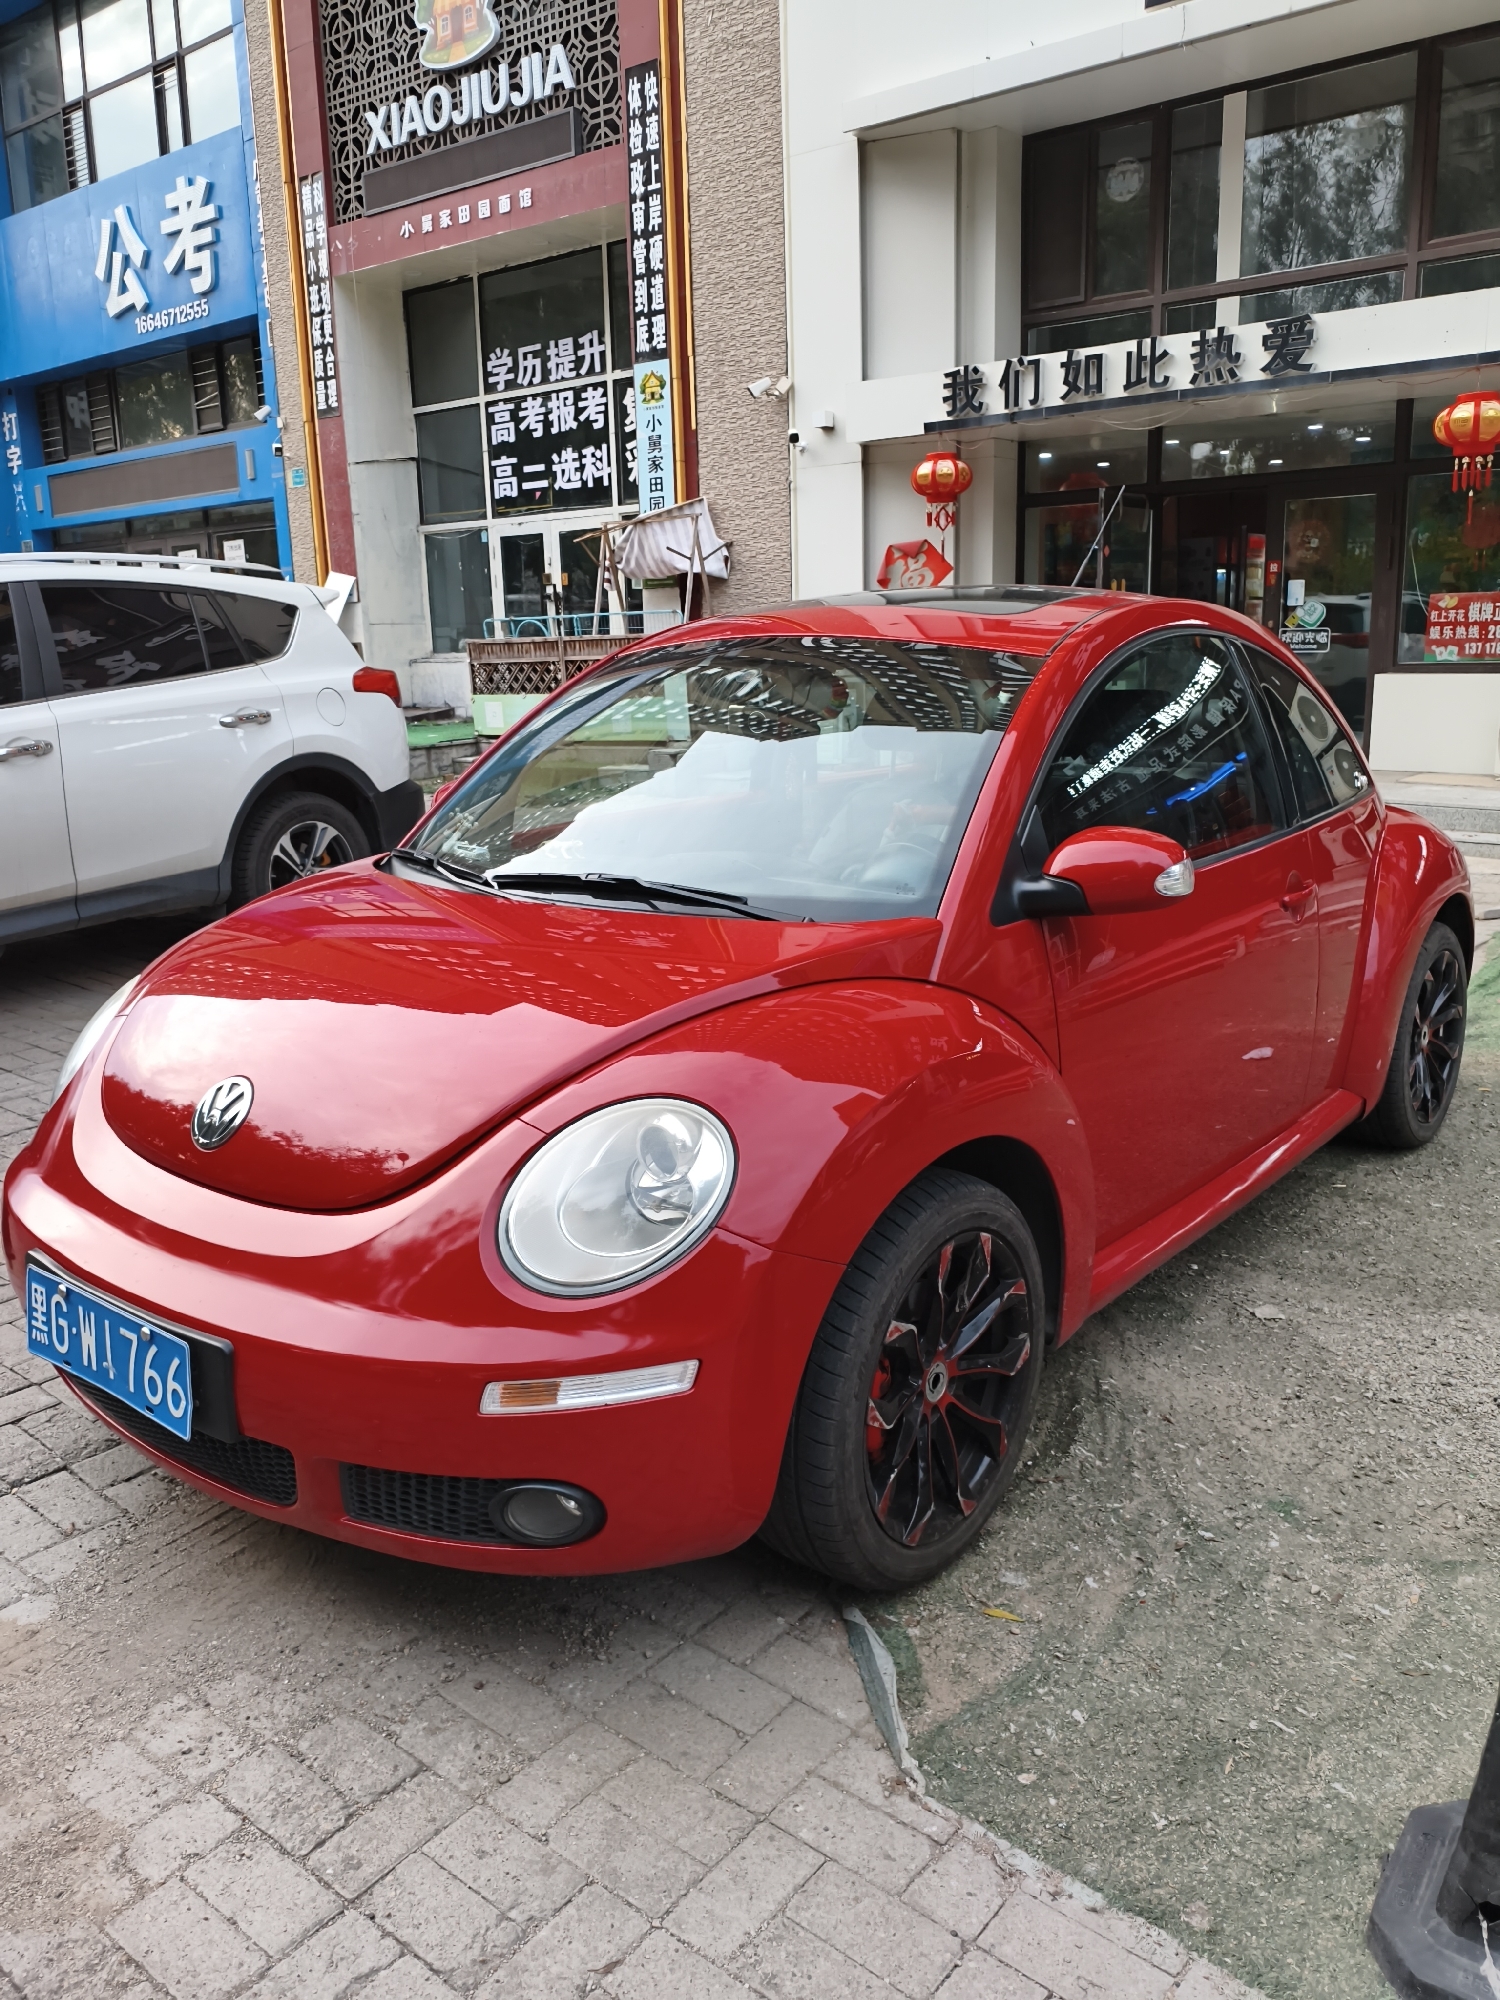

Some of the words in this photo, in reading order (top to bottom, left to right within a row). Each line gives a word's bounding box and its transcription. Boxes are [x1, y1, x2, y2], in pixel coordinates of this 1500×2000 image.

[364, 43, 577, 155] XIAOJIUJIA
[95, 175, 219, 318] 公考
[400, 187, 532, 239] 小舅家田园面馆
[628, 76, 649, 353] 体检政审管到底
[645, 70, 666, 350] 快速上岸硬道理
[134, 299, 209, 335] 16646712555
[301, 184, 326, 410] 精品小班保质量
[312, 180, 339, 408] 科学规划更合理
[487, 330, 606, 392] 学历提升
[942, 314, 1319, 418] 我们如此热爱
[2, 411, 22, 476] 打字
[488, 387, 607, 446] 高考报考
[490, 444, 611, 500] 高二选科
[645, 414, 665, 512] 小舅家田园
[1281, 631, 1328, 644] 欢迎光临
[1430, 609, 1466, 622] 杠上开花
